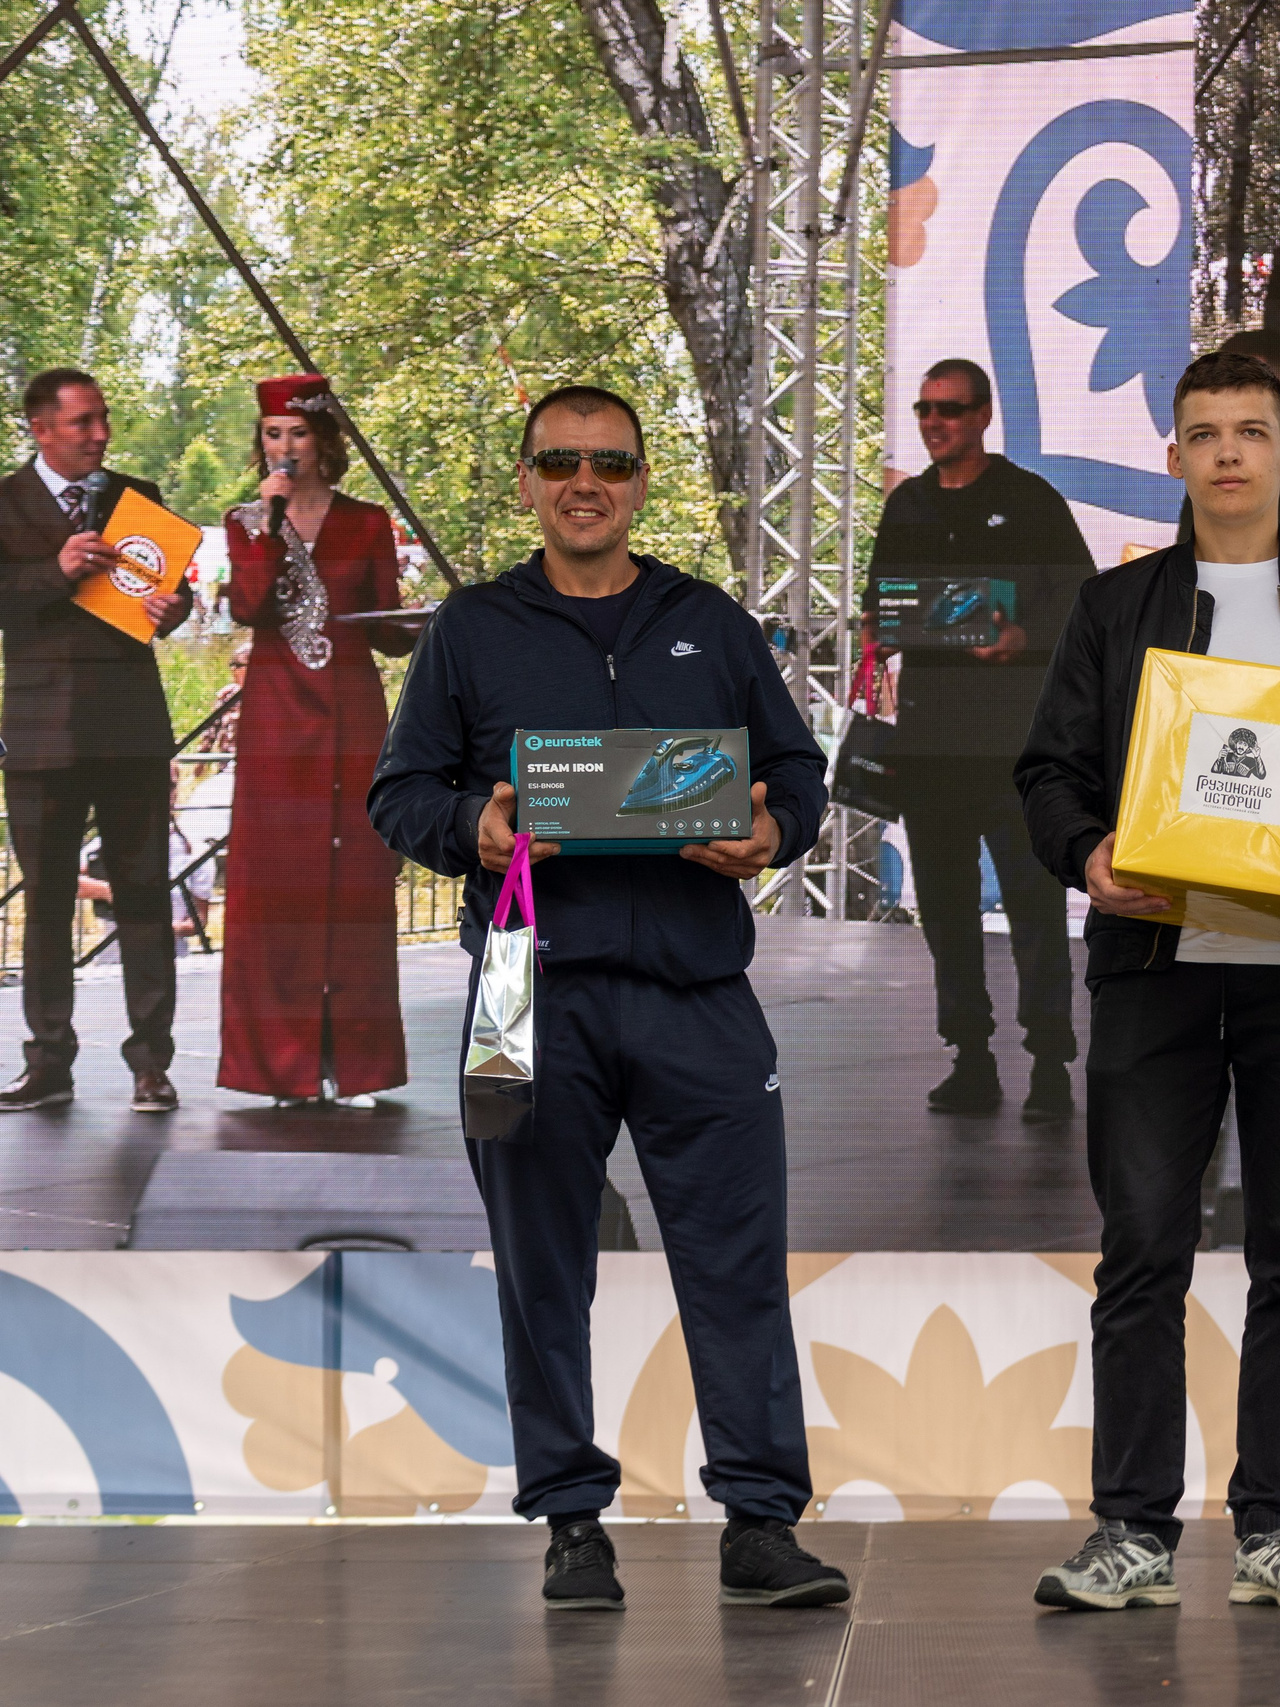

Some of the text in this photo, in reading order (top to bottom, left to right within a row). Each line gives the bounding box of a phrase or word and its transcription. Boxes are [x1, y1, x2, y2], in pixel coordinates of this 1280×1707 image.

[675, 640, 695, 651] NIKE
[544, 736, 603, 747] eurostek
[527, 763, 604, 773] STEAM IRON
[528, 797, 571, 807] 2400W
